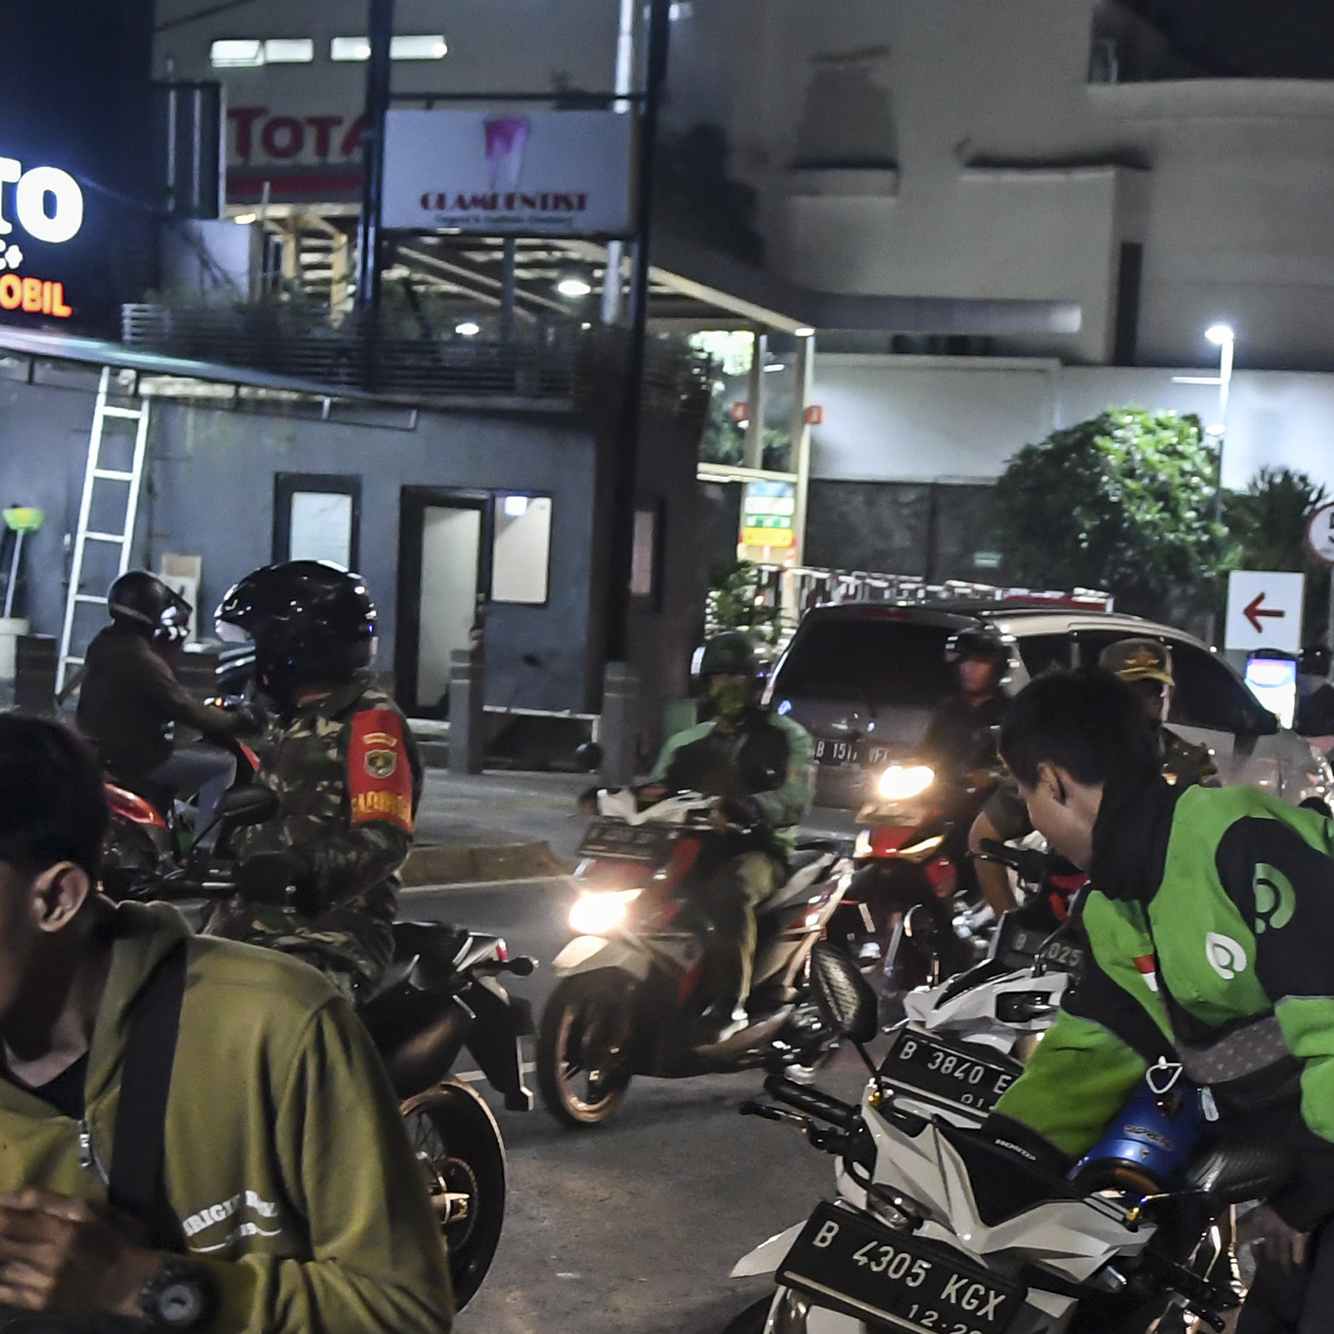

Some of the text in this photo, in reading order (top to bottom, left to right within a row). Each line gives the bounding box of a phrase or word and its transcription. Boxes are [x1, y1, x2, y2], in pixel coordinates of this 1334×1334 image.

[815, 740, 826, 758] B
[898, 1040, 918, 1061] B
[926, 1050, 986, 1085] 3840
[812, 1219, 1007, 1322] B 4305 KGX
